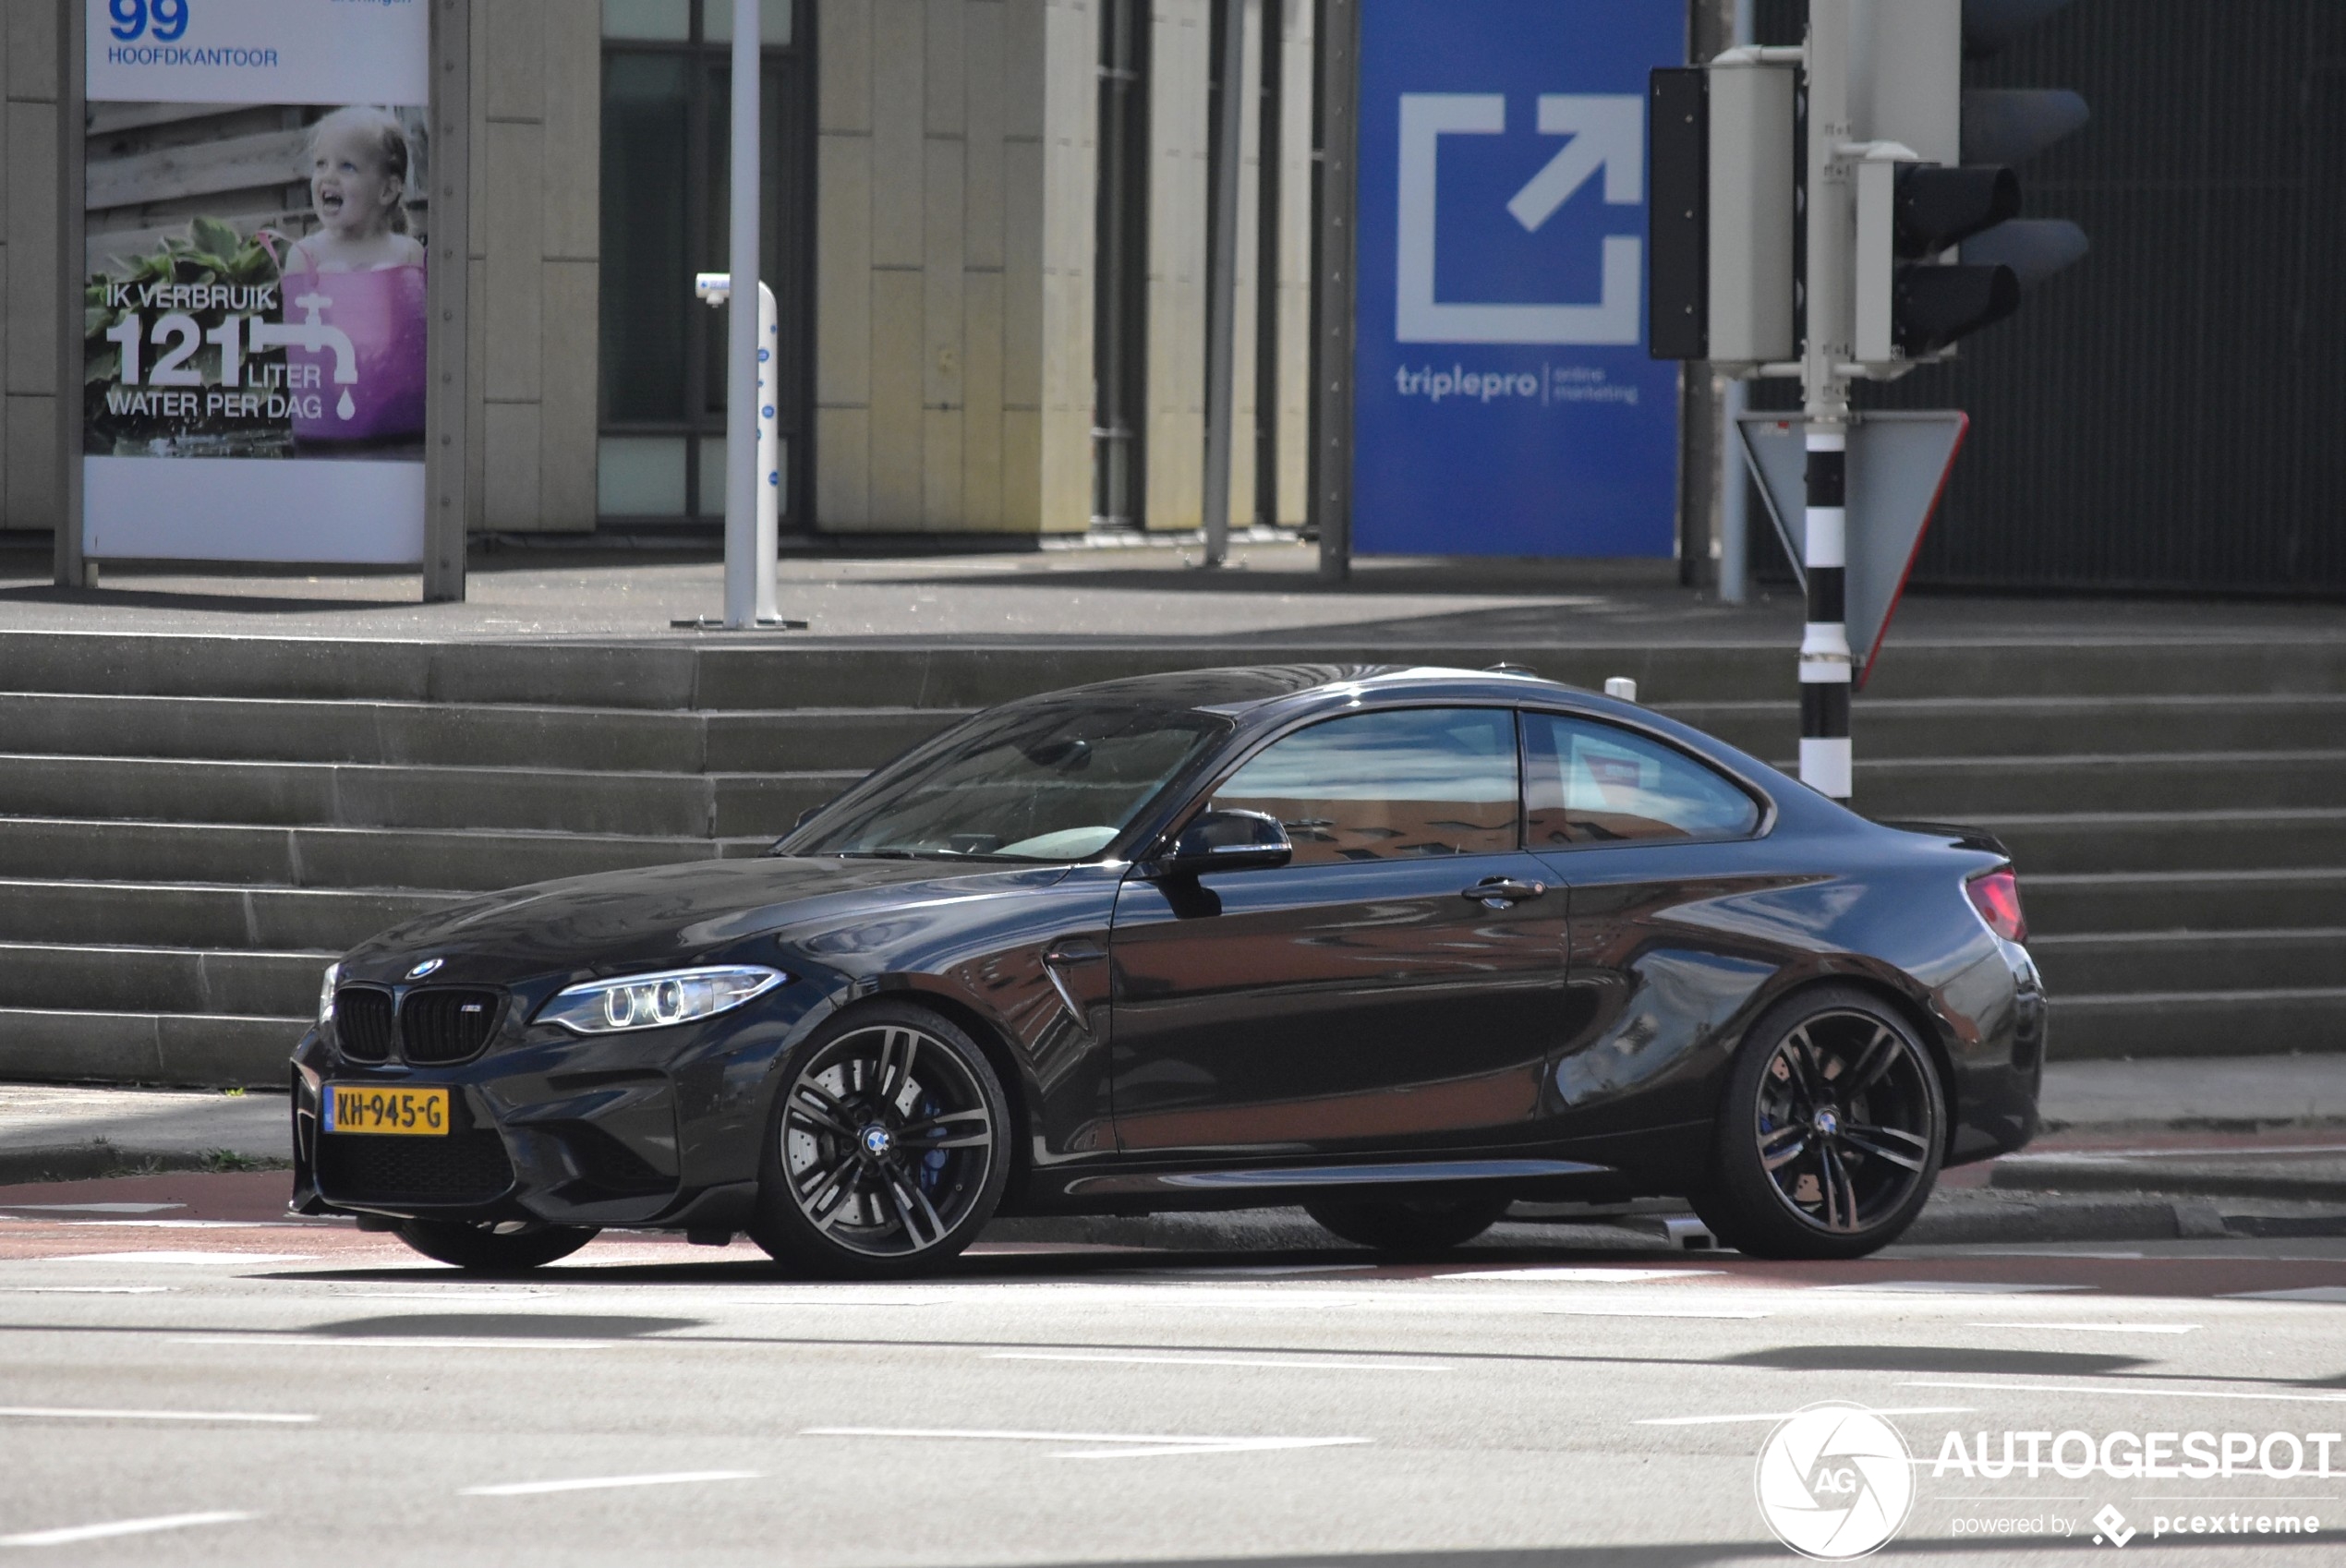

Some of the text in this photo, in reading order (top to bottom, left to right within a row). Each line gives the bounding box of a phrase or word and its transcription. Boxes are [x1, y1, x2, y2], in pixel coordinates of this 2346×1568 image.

[109, 0, 188, 42] 99
[108, 46, 278, 66] HOOFDKANTOOR
[106, 283, 277, 310] IK VERBRUIK
[106, 313, 320, 388] 121 LITER
[1396, 363, 1538, 404] triplepro
[106, 392, 322, 419] WATER PER DAG
[338, 1093, 441, 1128] KH-945-G
